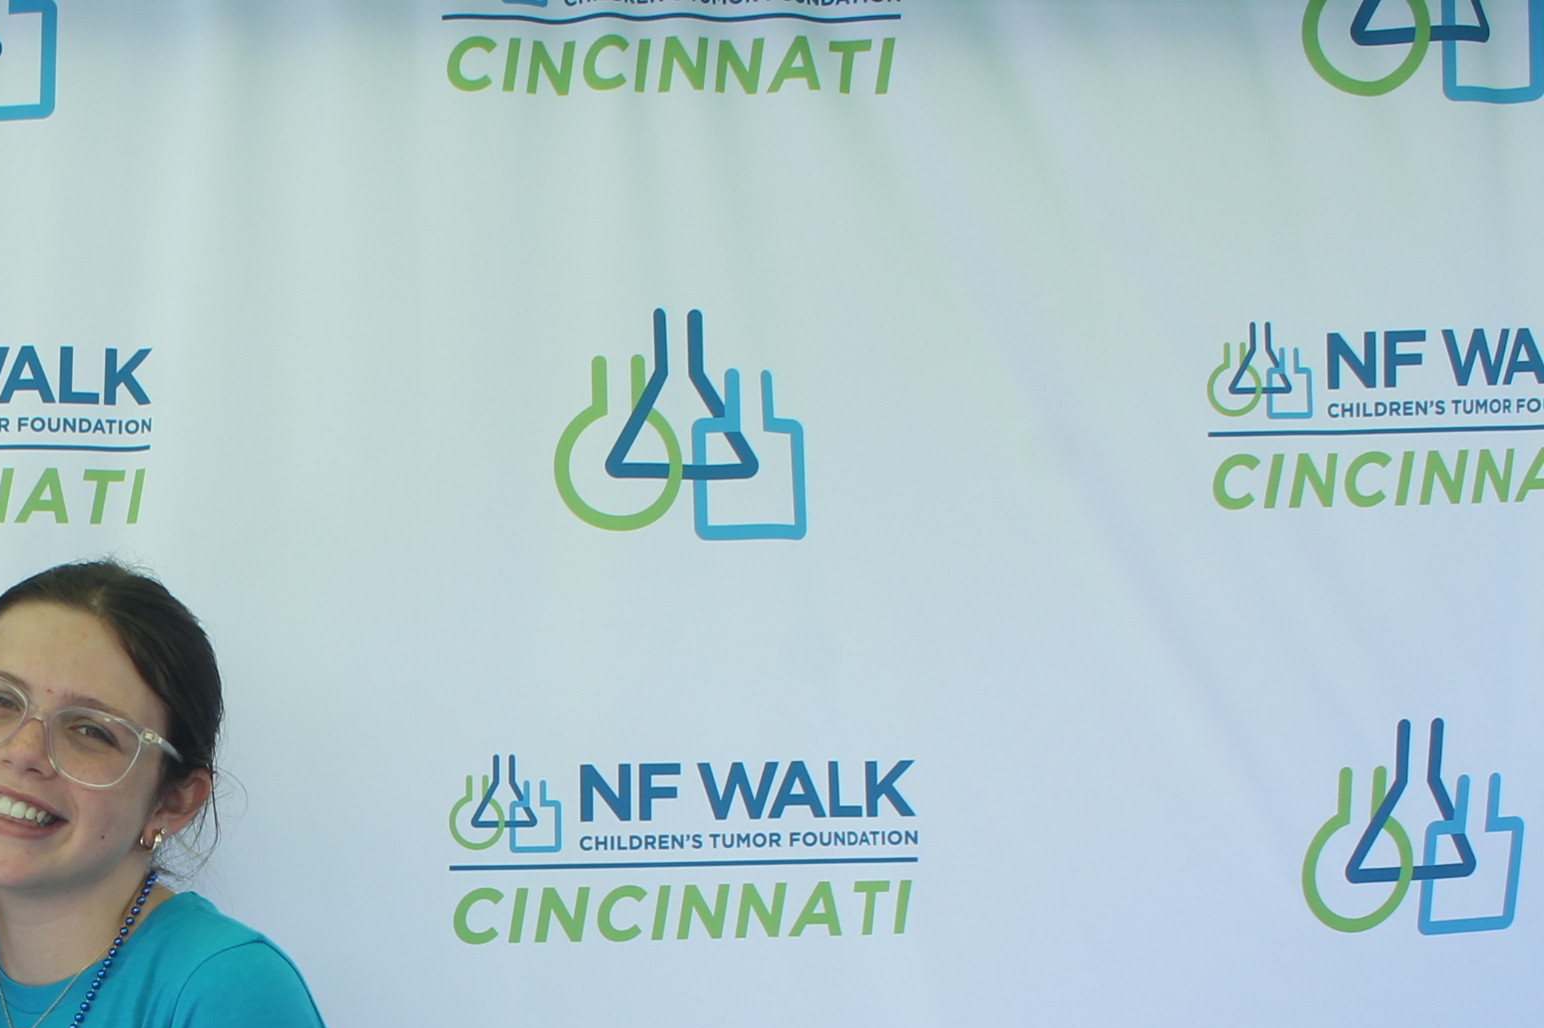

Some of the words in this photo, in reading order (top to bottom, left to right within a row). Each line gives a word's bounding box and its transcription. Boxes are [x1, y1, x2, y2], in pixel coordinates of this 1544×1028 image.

[446, 34, 896, 96] CINCINNATI
[1327, 329, 1426, 390] NF
[1441, 328, 1544, 387] WA
[17, 416, 153, 435] FOUNDATION
[1327, 400, 1446, 418] CHILDREN'S
[1451, 398, 1512, 415] TUMOR
[579, 763, 681, 822] NF
[696, 759, 916, 820] WALK
[579, 833, 703, 851] CHILDREN'S
[709, 831, 782, 849] TUMOR
[790, 830, 918, 847] FOUNDATION
[453, 879, 912, 945] CINCINNATI
